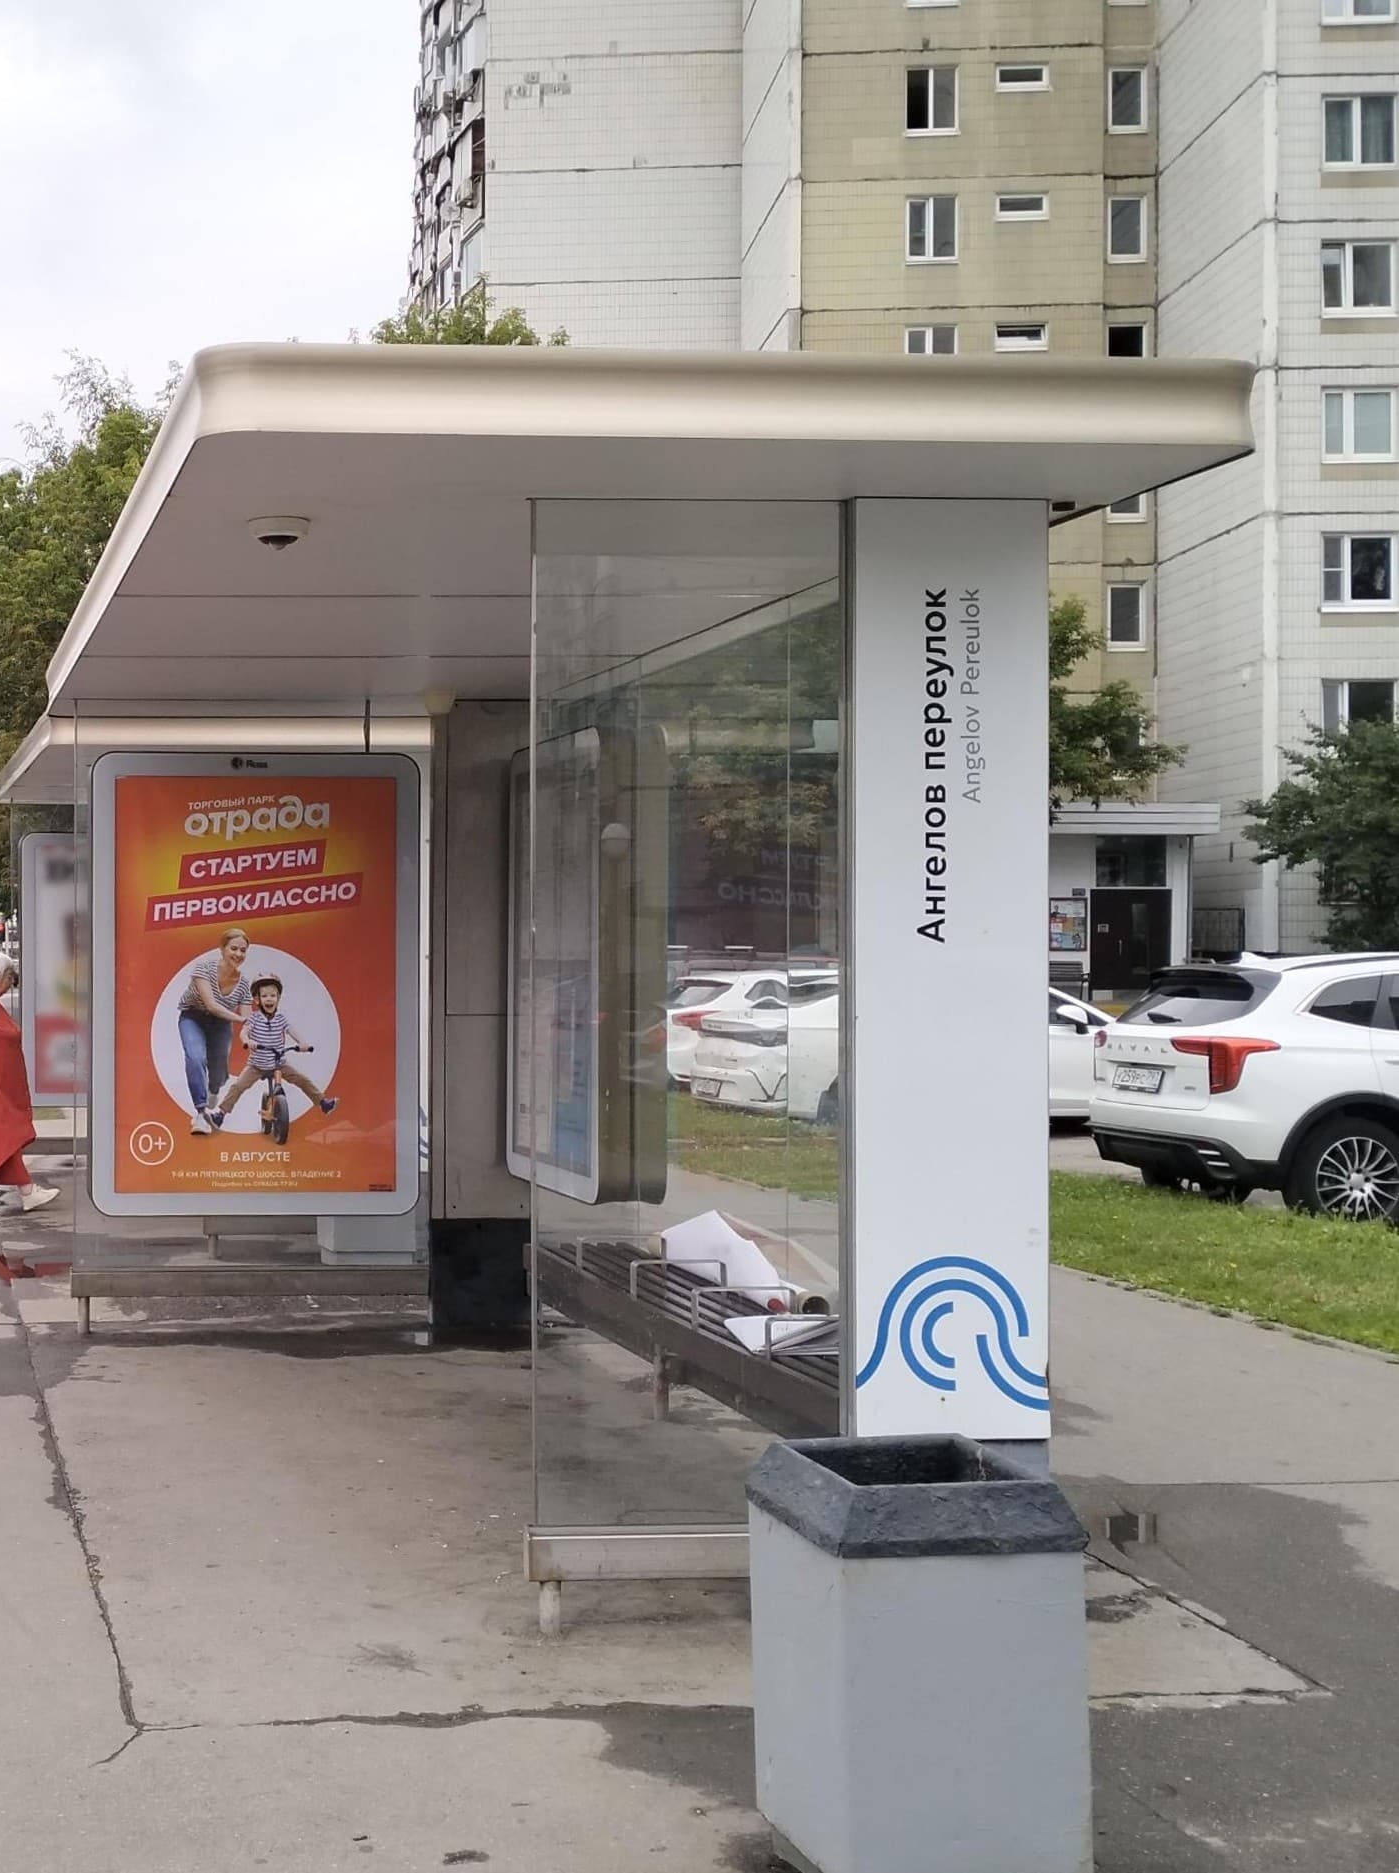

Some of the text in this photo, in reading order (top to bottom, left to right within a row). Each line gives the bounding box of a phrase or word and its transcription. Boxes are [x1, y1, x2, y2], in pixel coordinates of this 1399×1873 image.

[959, 589, 985, 803] Angelov Pereulok
[917, 587, 954, 943] Ангелов переулок
[188, 795, 275, 810] ТОРГОВЫЙ ПАРК
[190, 848, 316, 878] СТАРТУЕМ
[153, 881, 356, 921] ПЕРВОКЛАССНО
[138, 1134, 166, 1153] 0+
[220, 1152, 290, 1162] В АВГУСТЕ
